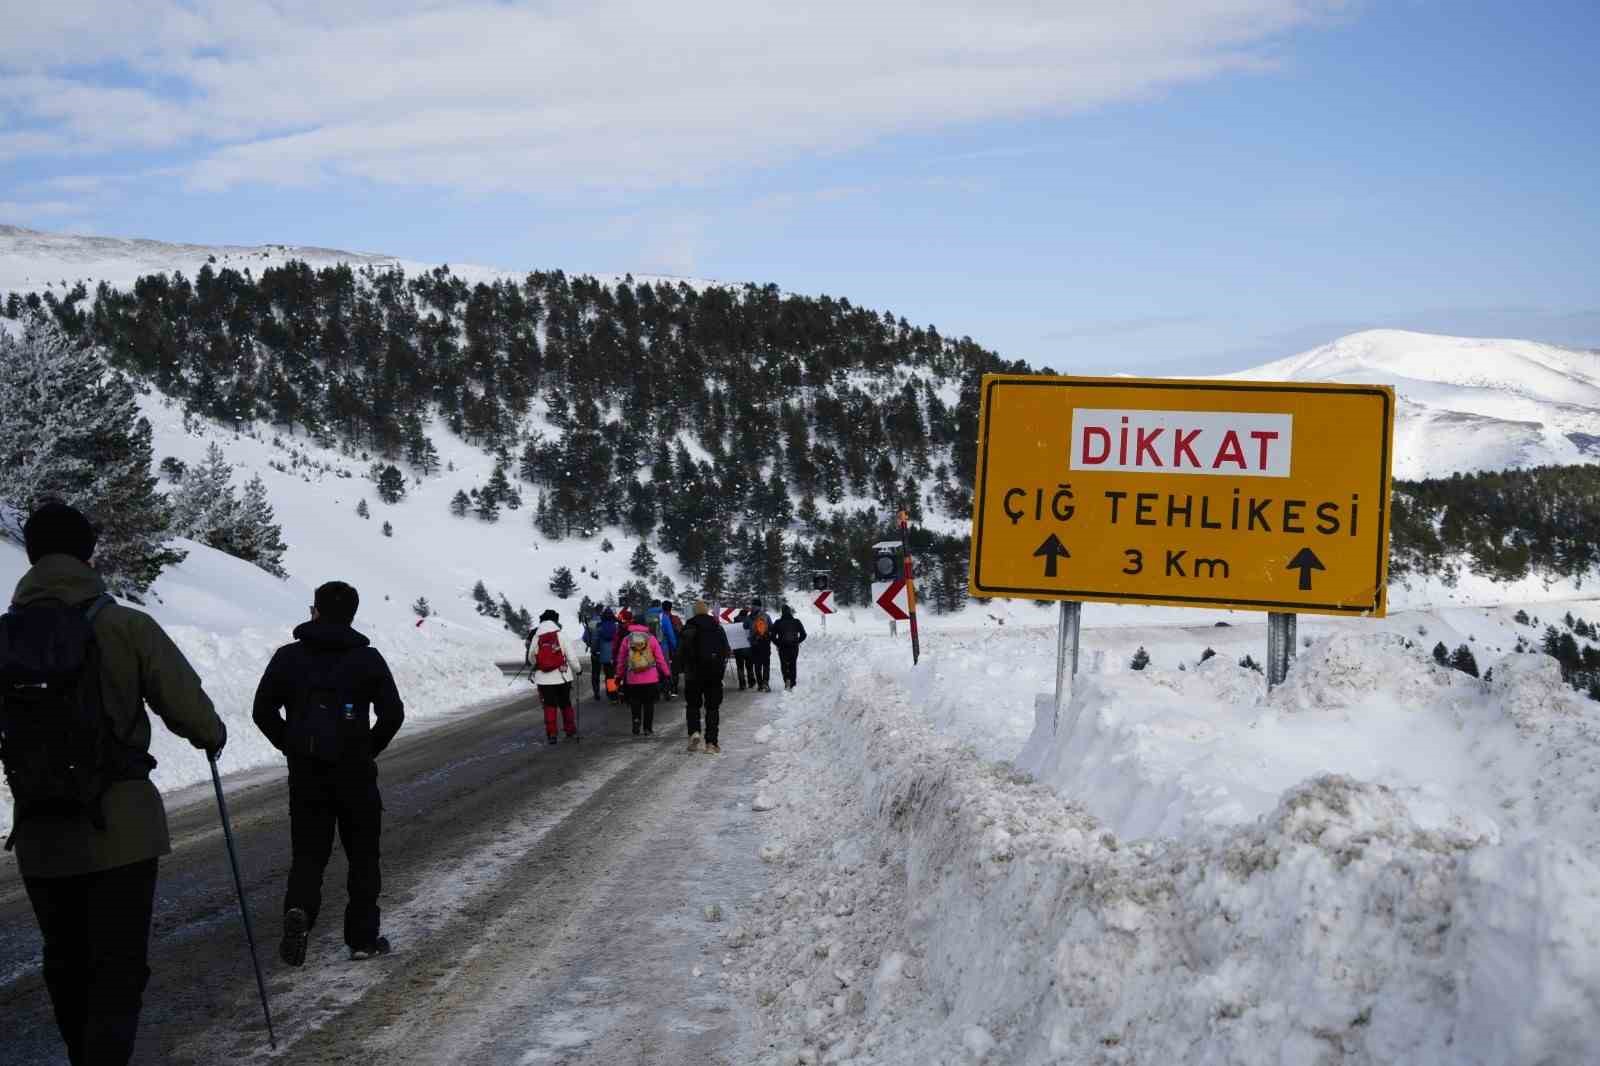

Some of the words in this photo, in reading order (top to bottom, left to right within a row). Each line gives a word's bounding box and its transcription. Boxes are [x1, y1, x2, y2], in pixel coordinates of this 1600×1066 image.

[1081, 416, 1279, 470] DİKKAT
[1003, 484, 1075, 525] ÇIĞ
[1105, 488, 1359, 537] TEHLİKESİ
[1122, 549, 1143, 575] 3
[1165, 550, 1229, 578] Km
